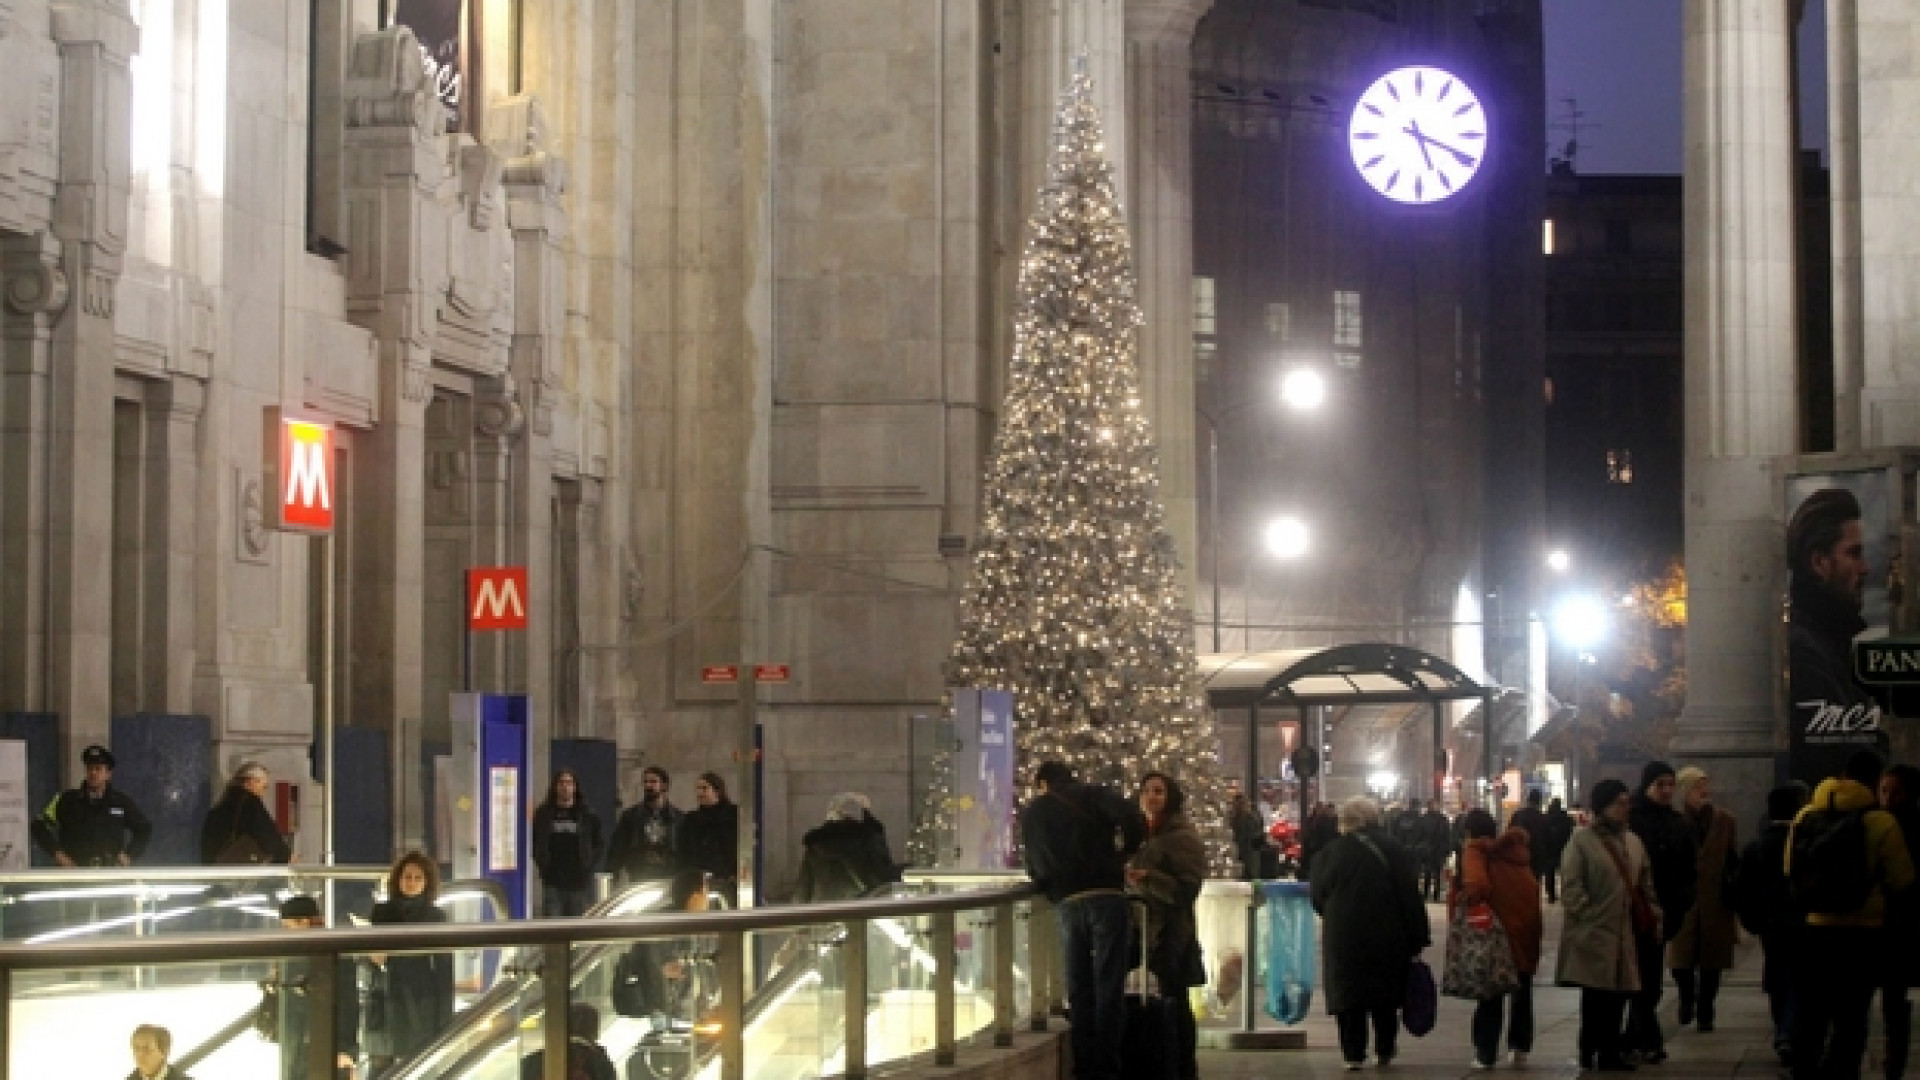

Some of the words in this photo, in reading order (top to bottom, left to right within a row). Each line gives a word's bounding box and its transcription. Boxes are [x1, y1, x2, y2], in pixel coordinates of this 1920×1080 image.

[285, 439, 330, 509] M
[474, 578, 524, 619] M
[1867, 649, 1920, 672] PAN
